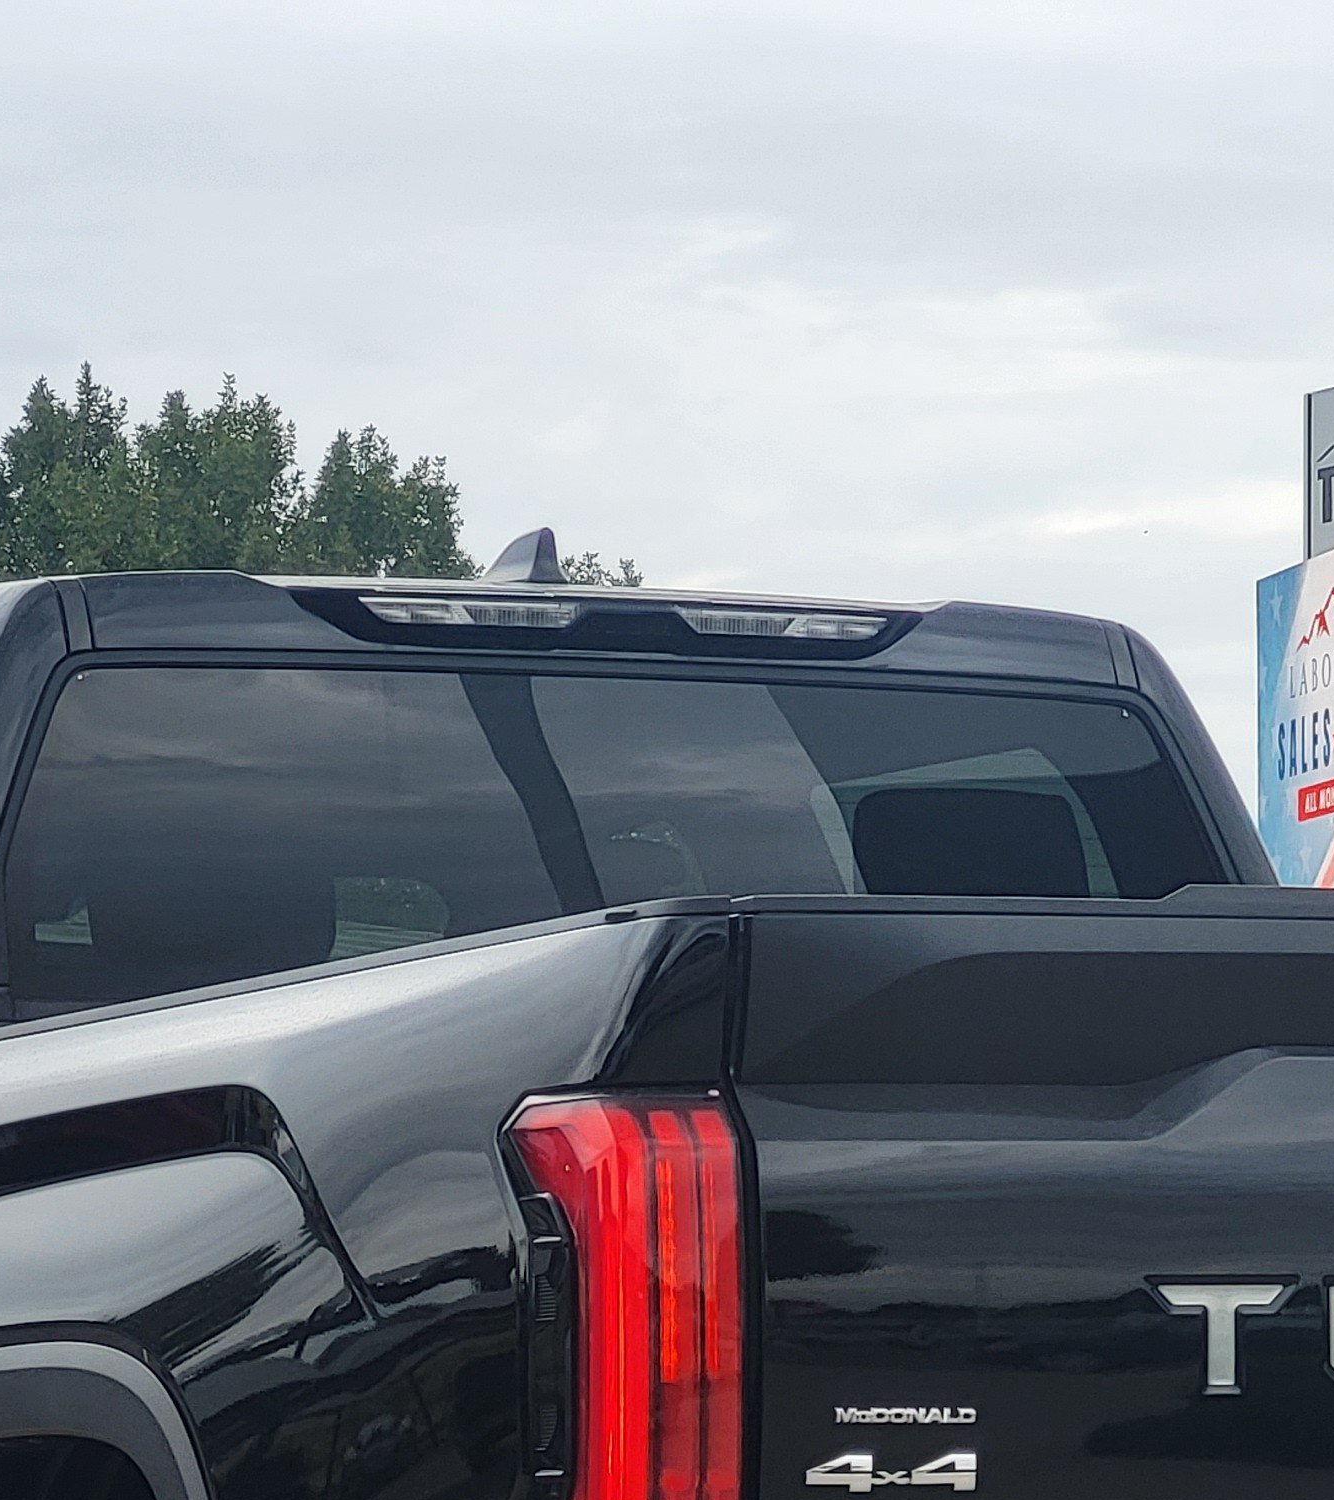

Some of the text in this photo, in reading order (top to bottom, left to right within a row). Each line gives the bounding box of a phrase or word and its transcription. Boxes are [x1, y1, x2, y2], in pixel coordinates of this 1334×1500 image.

[1277, 707, 1331, 781] SALES
[1304, 791, 1318, 814] ALL
[833, 1406, 978, 1424] McDONALD
[805, 1453, 978, 1493] 4x4
